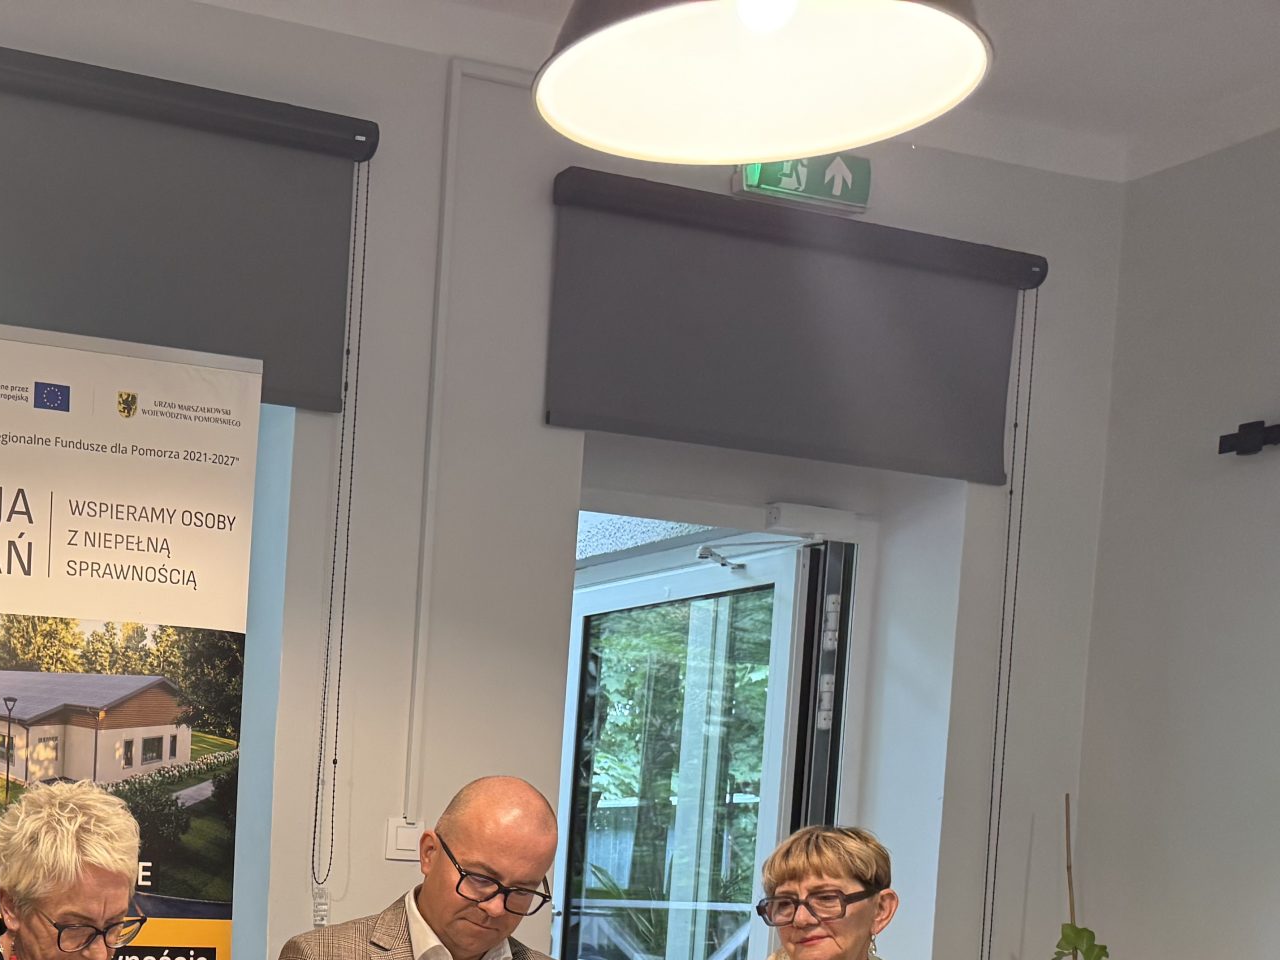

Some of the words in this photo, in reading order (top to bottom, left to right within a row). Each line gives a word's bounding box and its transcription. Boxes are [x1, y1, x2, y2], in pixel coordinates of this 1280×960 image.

[10, 385, 29, 393] przez
[54, 436, 108, 453] Fundusze
[110, 443, 128, 455] dla
[131, 445, 180, 460] Pomorza
[69, 499, 177, 525] WSPIERAMY
[181, 510, 236, 531] OSOBY
[67, 529, 79, 546] Z
[84, 531, 171, 558] NIEPEŁNĄ
[66, 560, 197, 590] SPRAWNOŚCIĄ
